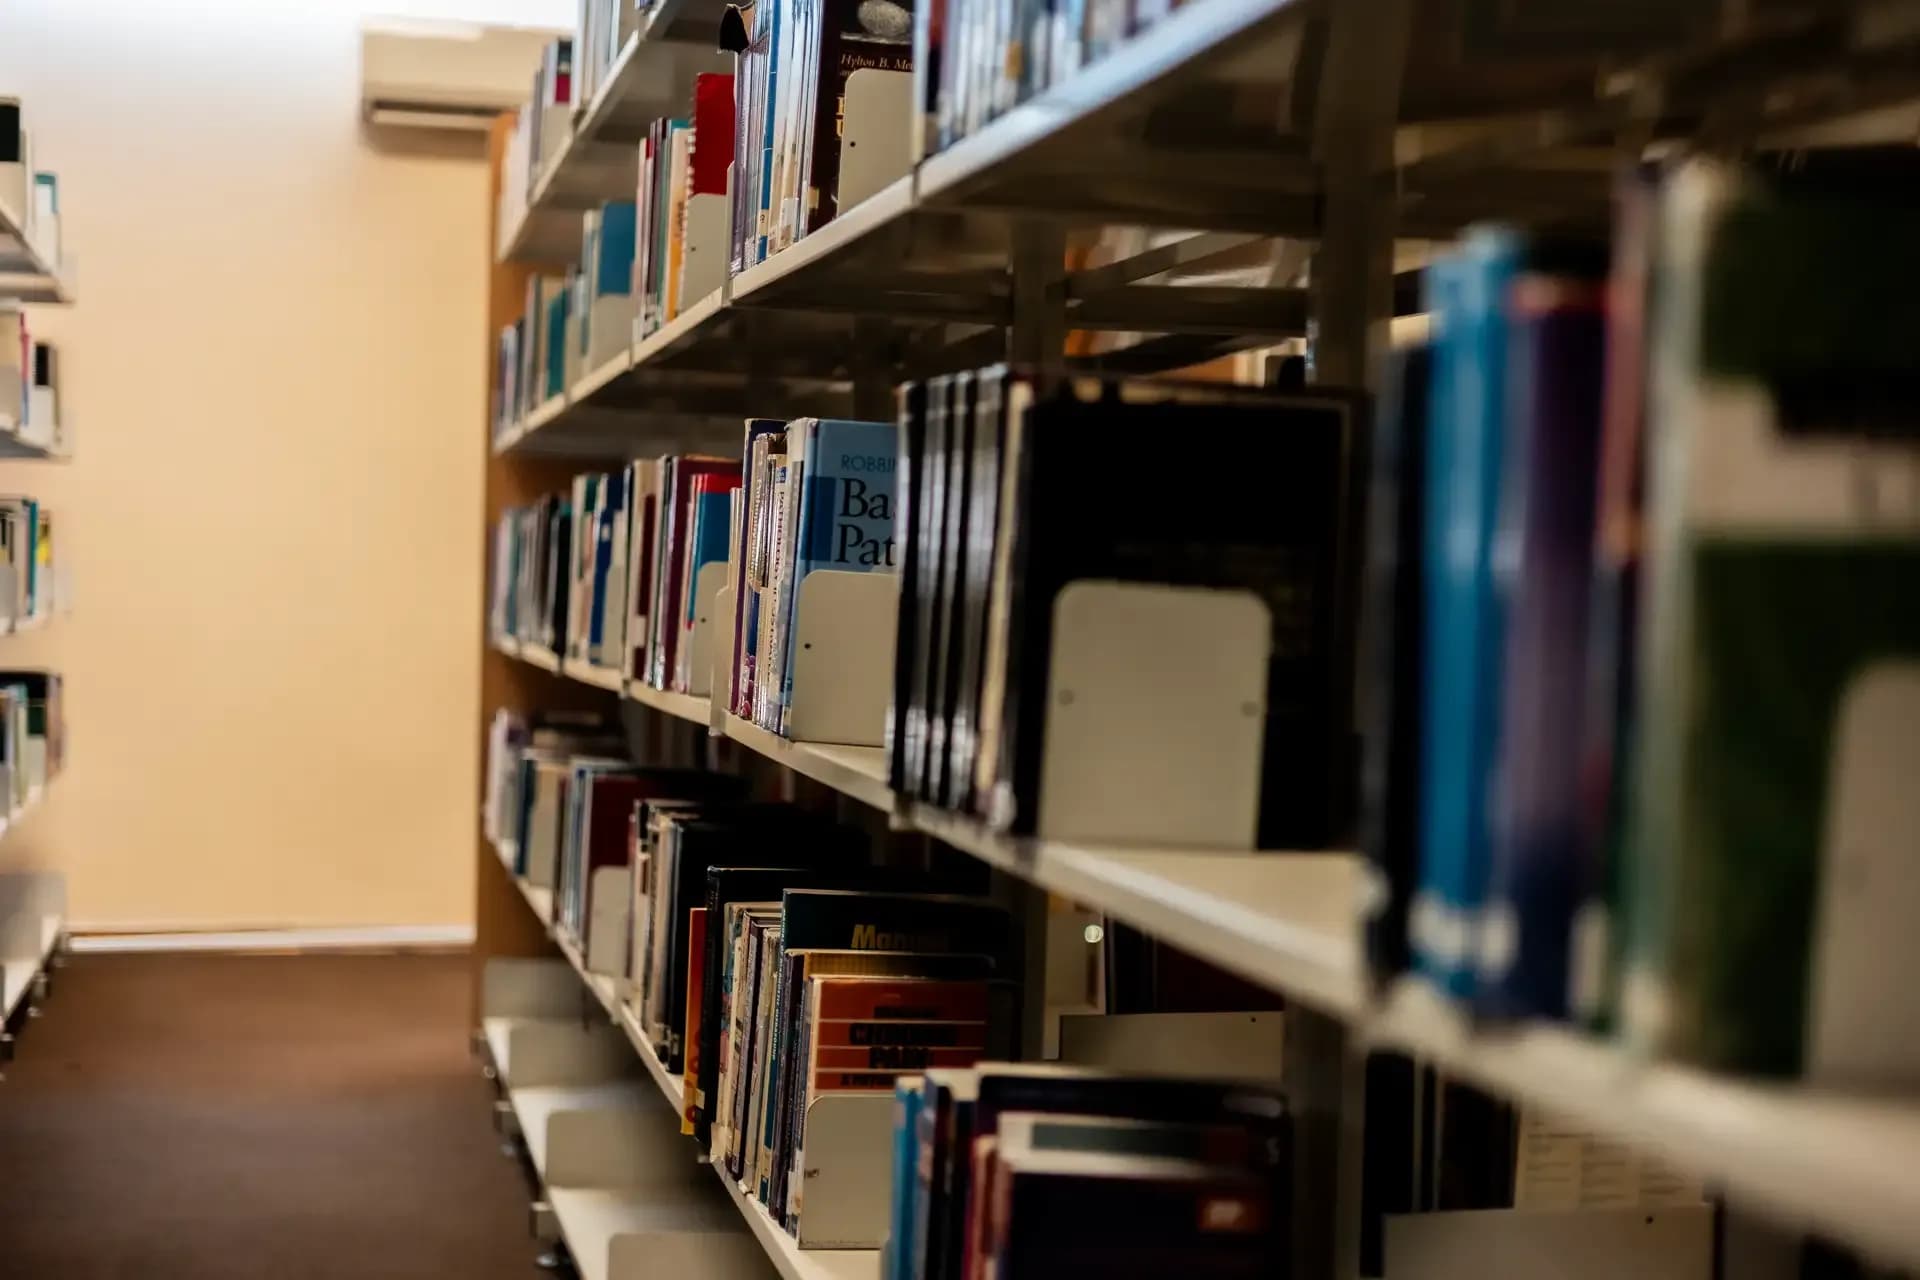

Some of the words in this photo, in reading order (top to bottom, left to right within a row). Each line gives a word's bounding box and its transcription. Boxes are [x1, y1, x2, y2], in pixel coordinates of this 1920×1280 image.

[841, 54, 875, 68] Hylton
[879, 57, 889, 69] B.
[838, 478, 893, 520] Ba
